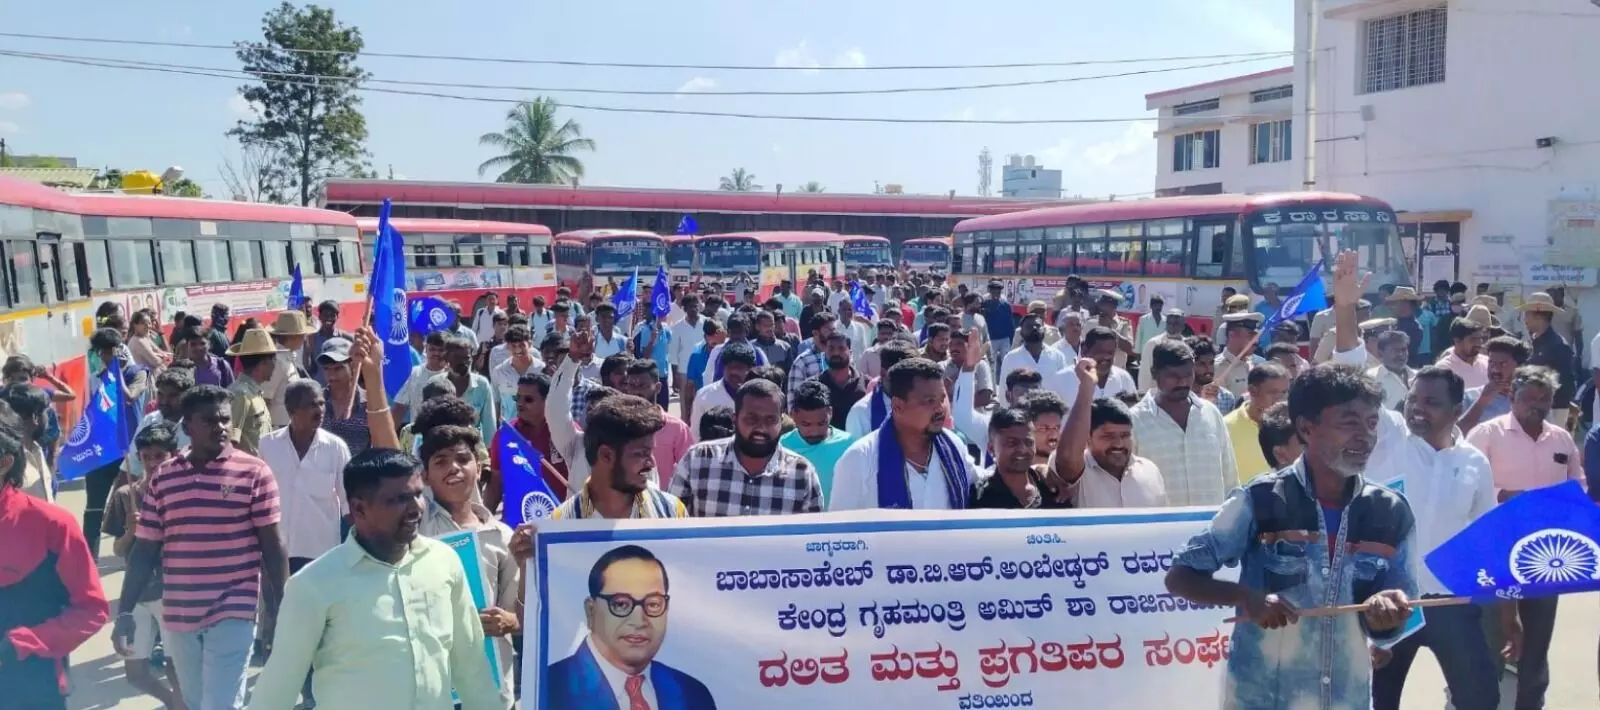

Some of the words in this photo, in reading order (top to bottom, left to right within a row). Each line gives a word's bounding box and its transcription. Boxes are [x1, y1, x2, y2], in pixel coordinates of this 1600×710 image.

[715, 559, 874, 592] ಬಾಬಾಸಾಹೇಬ್
[778, 601, 847, 638] ಕೇಂದ್ರ
[859, 598, 966, 639] ಗೃಹಮಂತ್ರಿ
[978, 593, 1053, 621] ಅಮಿತ್
[1064, 596, 1097, 617] ಶಾ
[758, 647, 850, 688] ದಲಿತ
[870, 641, 961, 692] ಮತ್ತು
[978, 633, 1125, 688] ಪ್ರಗತಿಪರ
[958, 689, 1034, 709] ವತಿಯಿಂದ
